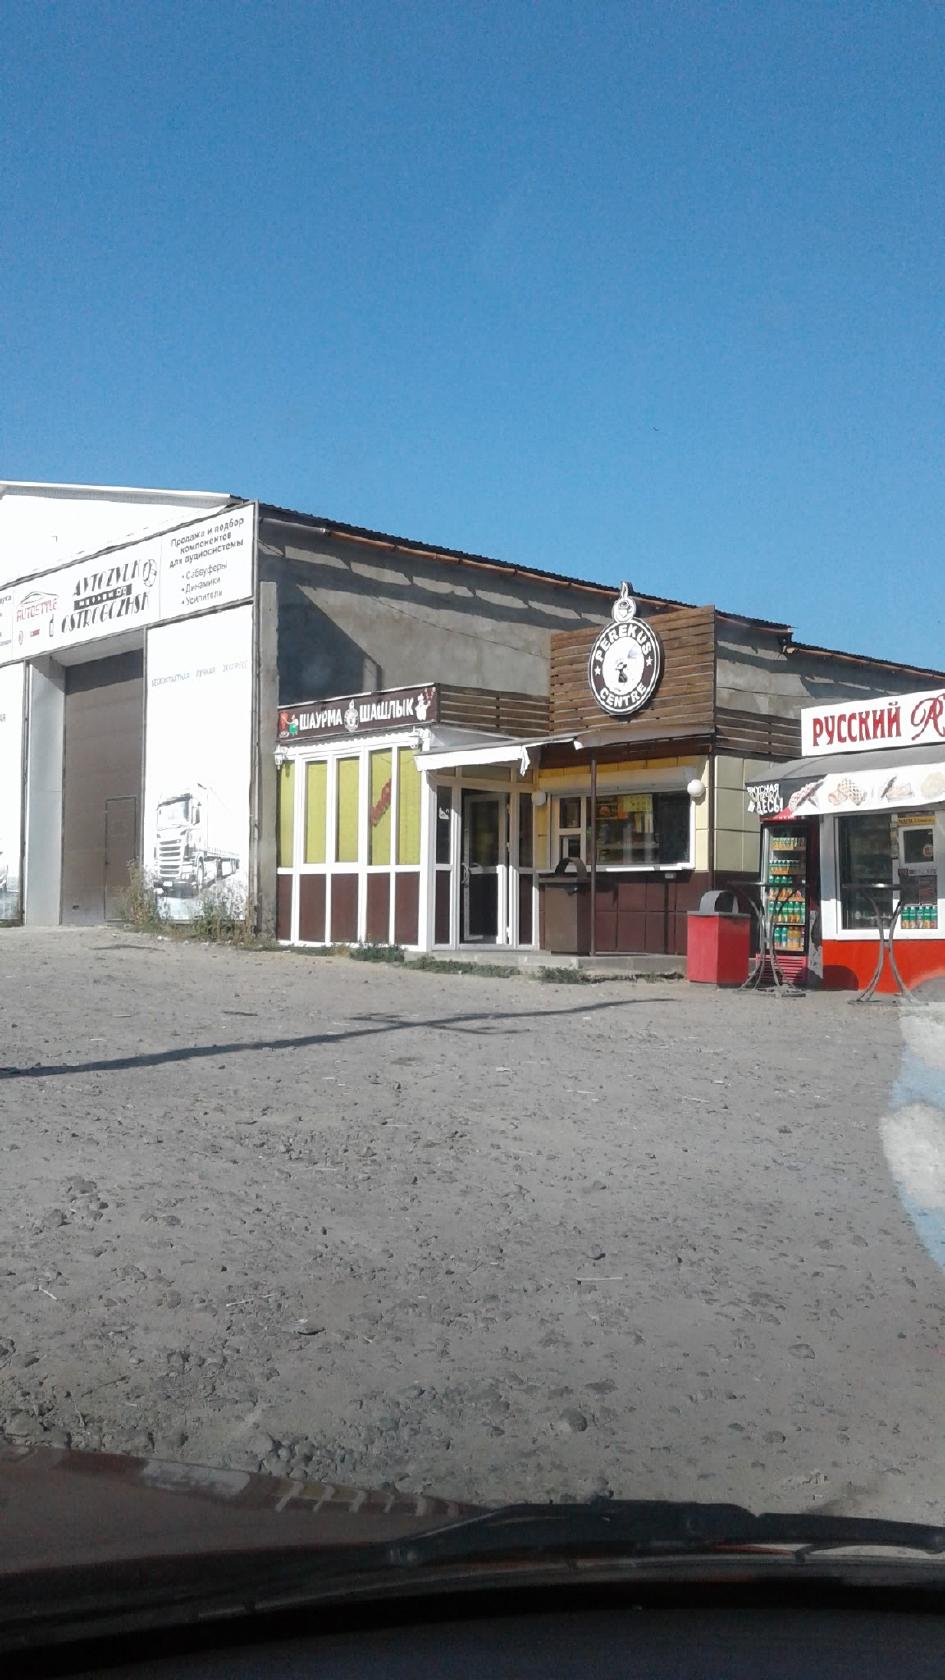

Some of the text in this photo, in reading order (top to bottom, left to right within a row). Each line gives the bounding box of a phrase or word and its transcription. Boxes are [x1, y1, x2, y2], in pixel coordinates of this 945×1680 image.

[171, 531, 205, 547] Продажа
[214, 517, 244, 533] подбор
[180, 532, 232, 555] компонентов
[169, 539, 244, 568] для аудиосистемы
[185, 577, 221, 593] Динамики
[595, 623, 652, 662] PEREKUS
[600, 683, 647, 708] CENTRE
[299, 697, 414, 730] ШАУРМА ШАШЛЫК
[812, 701, 902, 747] РУССКИЙ
